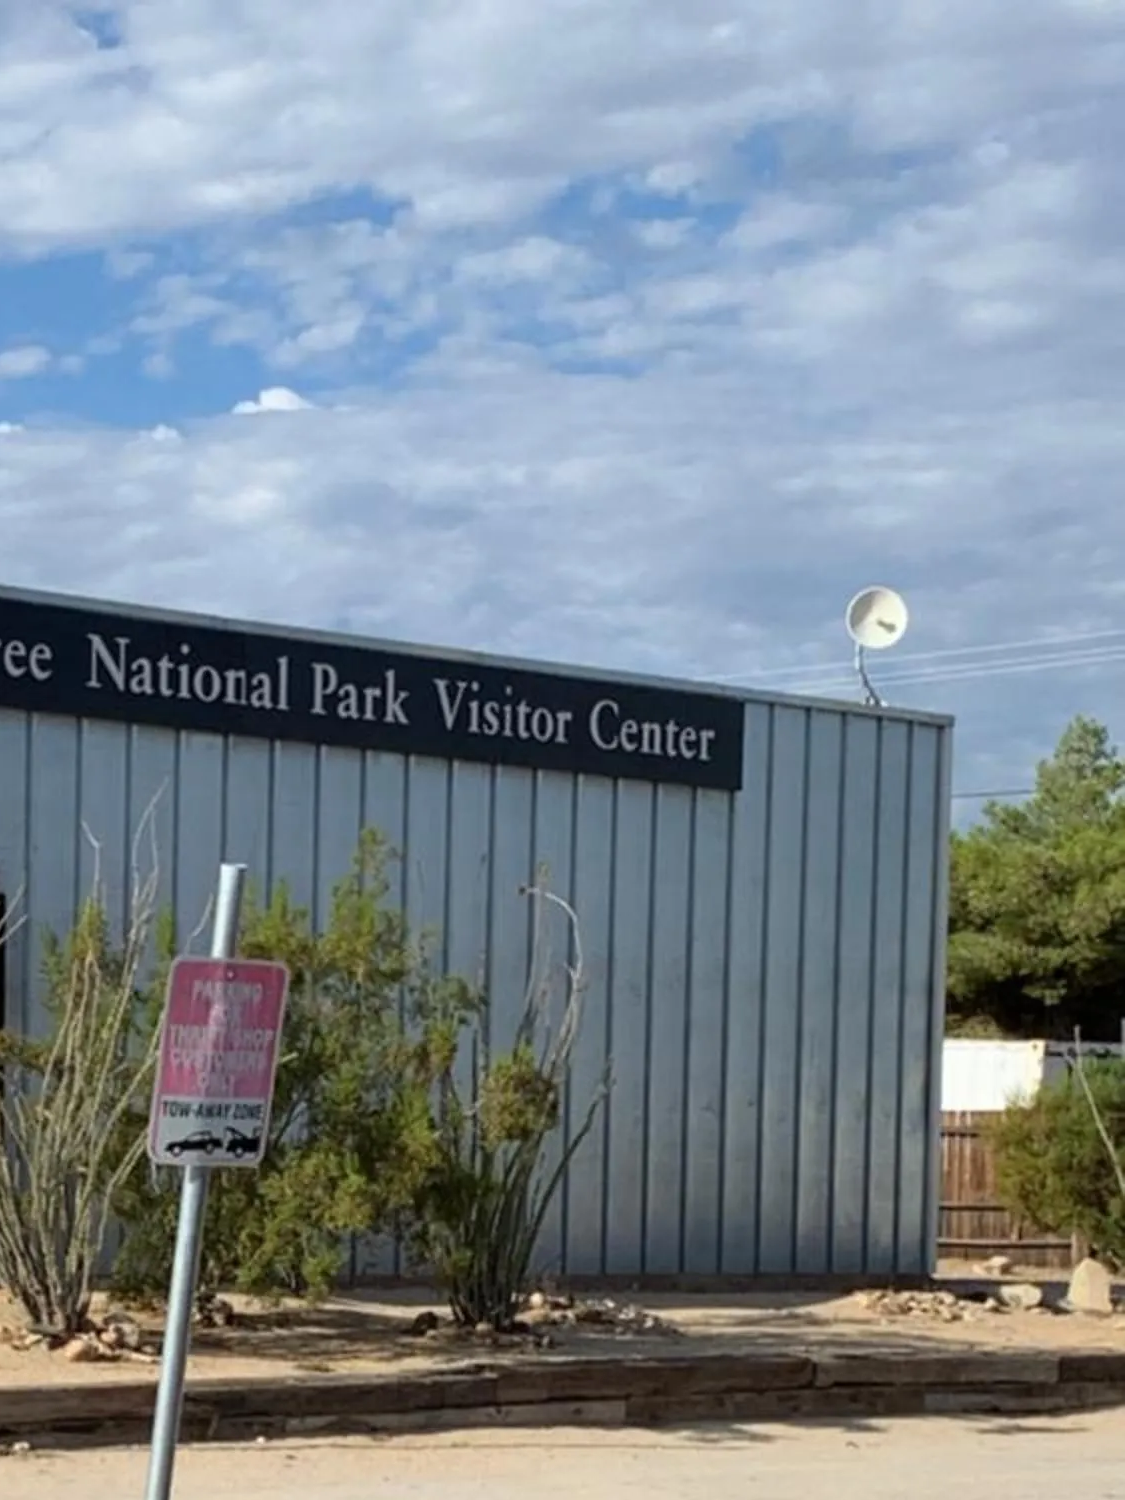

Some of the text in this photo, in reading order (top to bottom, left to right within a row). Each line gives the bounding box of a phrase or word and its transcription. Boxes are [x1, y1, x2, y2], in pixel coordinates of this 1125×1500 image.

[85, 632, 289, 711] National
[310, 661, 410, 726] Park
[432, 677, 572, 744] Visitor
[589, 700, 716, 762] Center
